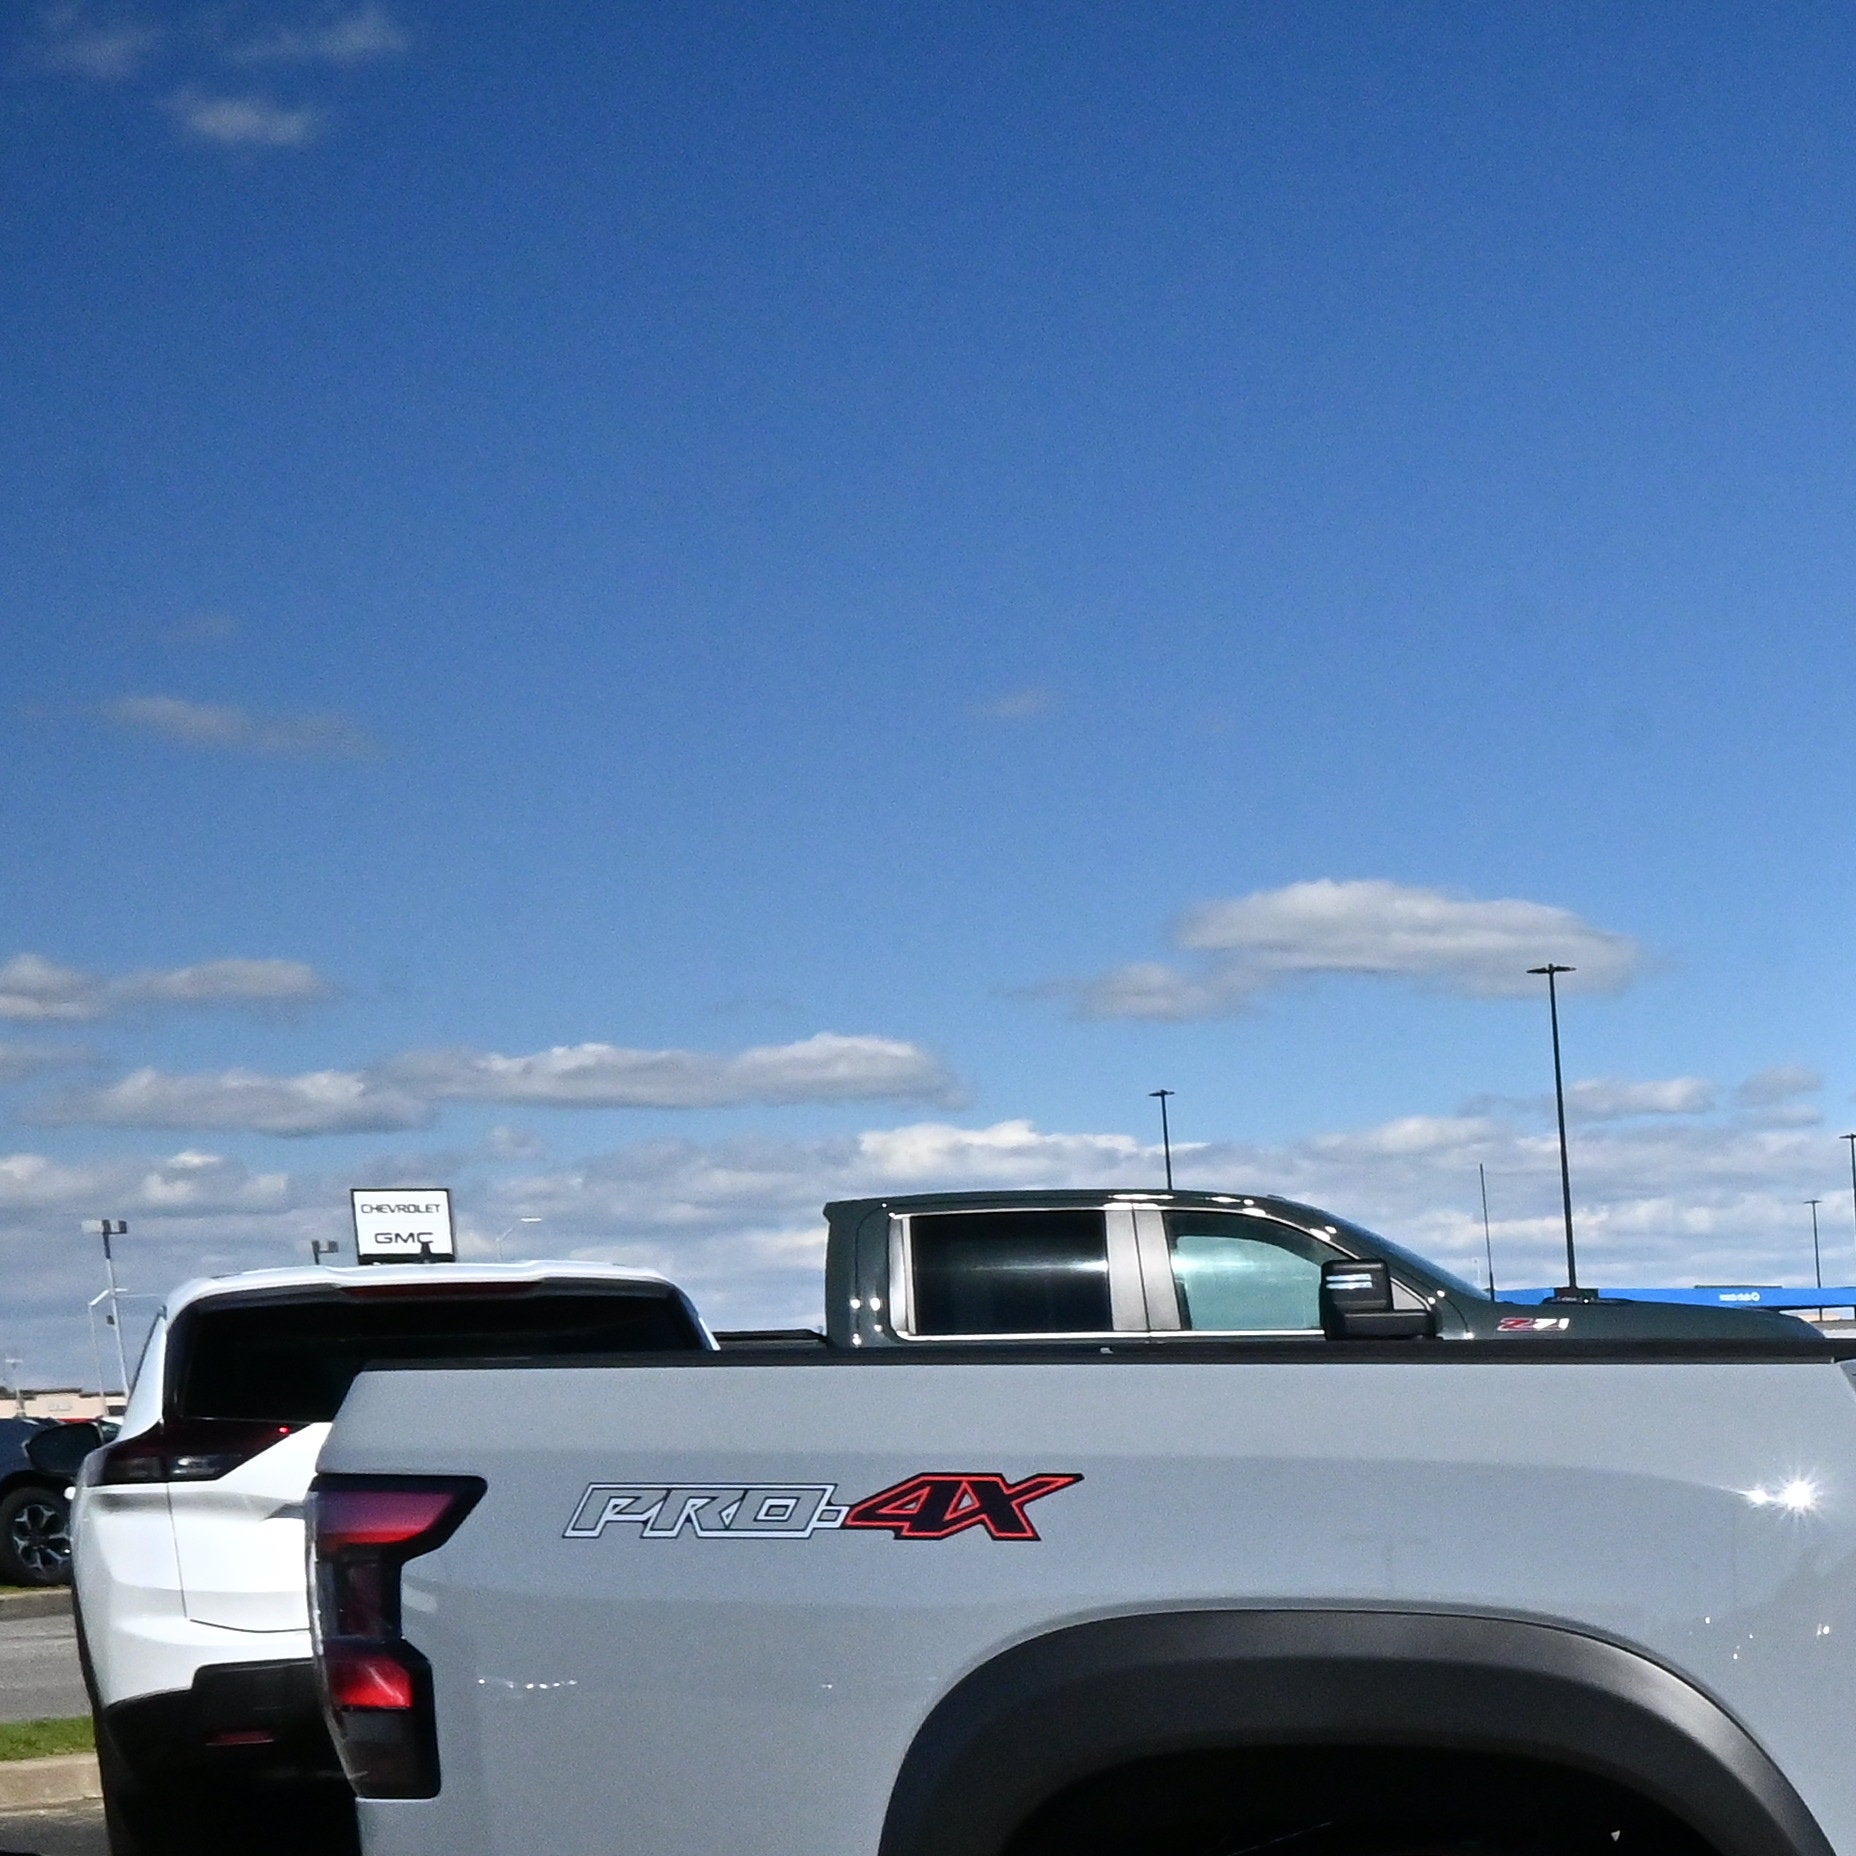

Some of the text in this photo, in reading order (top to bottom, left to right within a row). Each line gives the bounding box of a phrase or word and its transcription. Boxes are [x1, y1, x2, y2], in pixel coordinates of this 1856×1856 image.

[360, 1203, 441, 1214] CHEVROLET
[374, 1232, 434, 1244] GMC
[1496, 1317, 1570, 1331] Z71
[562, 1473, 1084, 1541] PRO-4X
